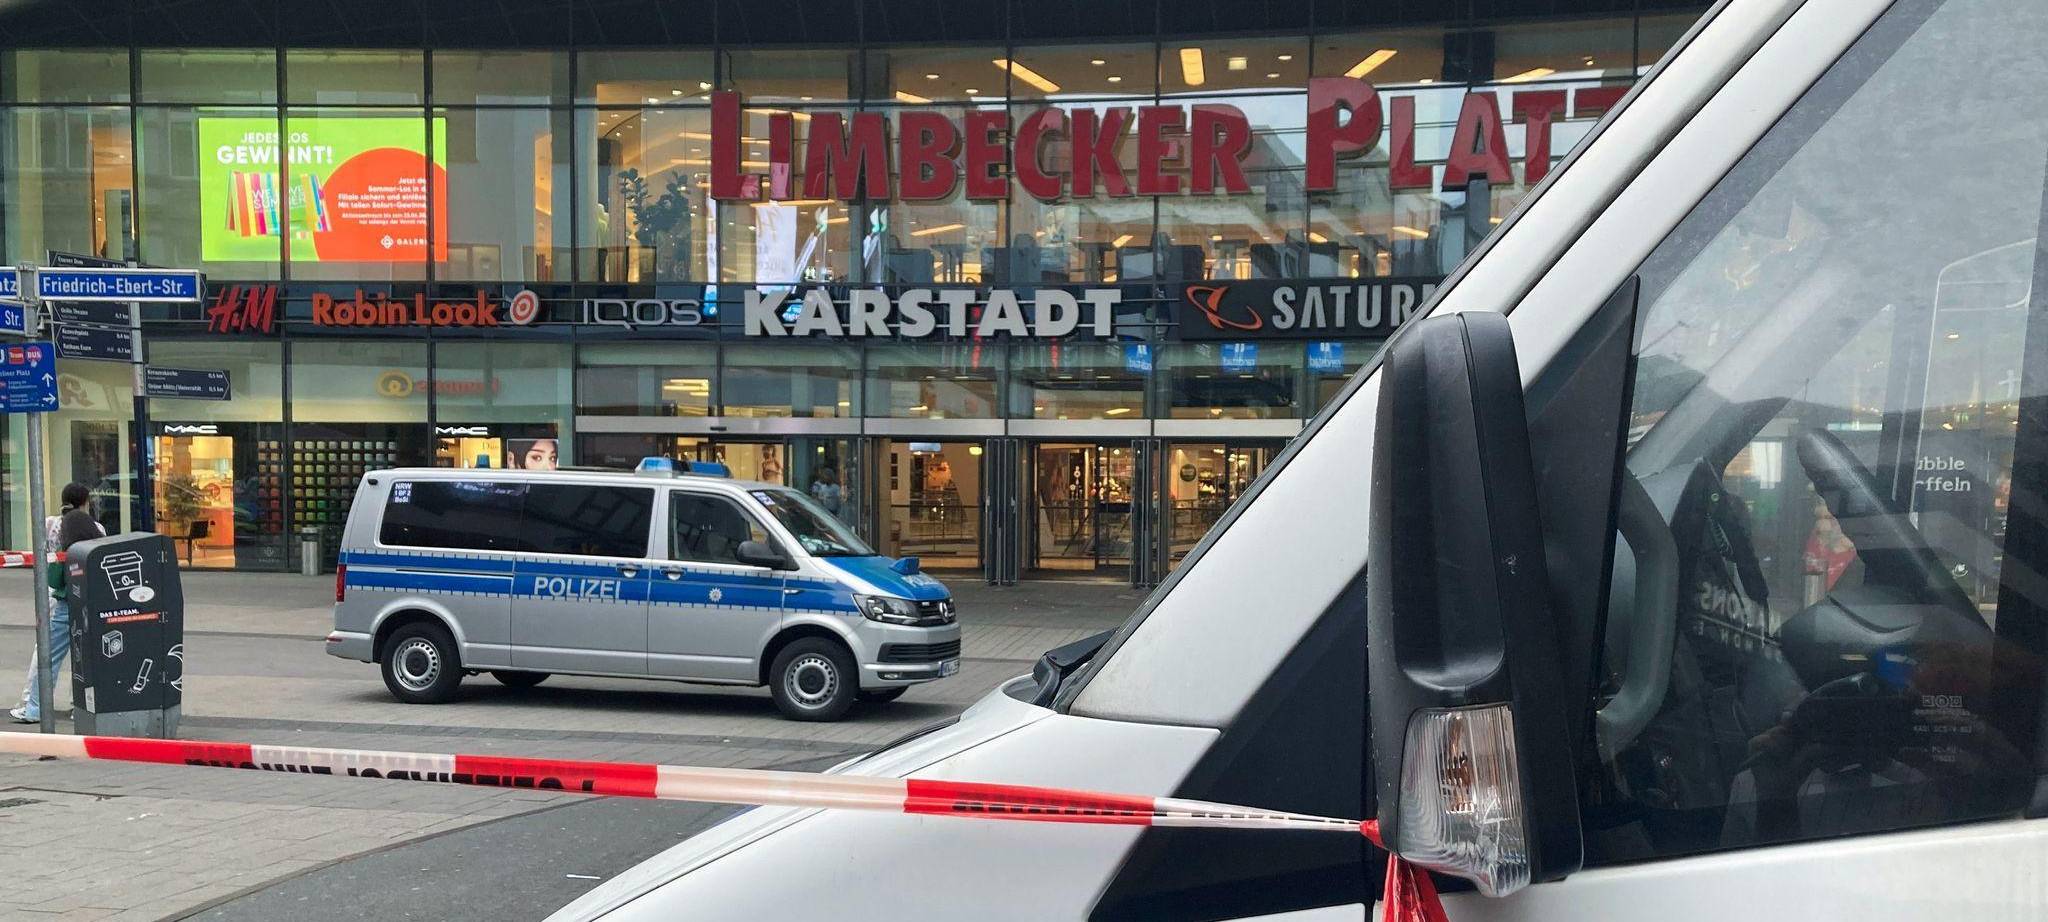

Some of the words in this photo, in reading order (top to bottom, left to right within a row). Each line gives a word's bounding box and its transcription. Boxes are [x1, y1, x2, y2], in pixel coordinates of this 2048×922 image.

[241, 132, 278, 143] JEDES
[287, 132, 308, 143] OS
[711, 91, 1254, 200] LIMBECKER
[1305, 77, 1634, 190] PLAT
[216, 145, 333, 164] GEWINT!
[43, 276, 187, 295] Friedrich-Ebert-Str.
[4, 310, 21, 326] Str.
[207, 286, 277, 334] H&M
[312, 288, 408, 326] Robin
[415, 288, 498, 326] Look
[583, 298, 701, 330] IQOS
[744, 288, 1121, 337] KARSTADT
[1271, 284, 1441, 329] SATUR
[164, 424, 218, 434] MAC
[436, 426, 488, 435] MAC
[533, 576, 621, 599] POLIZEI
